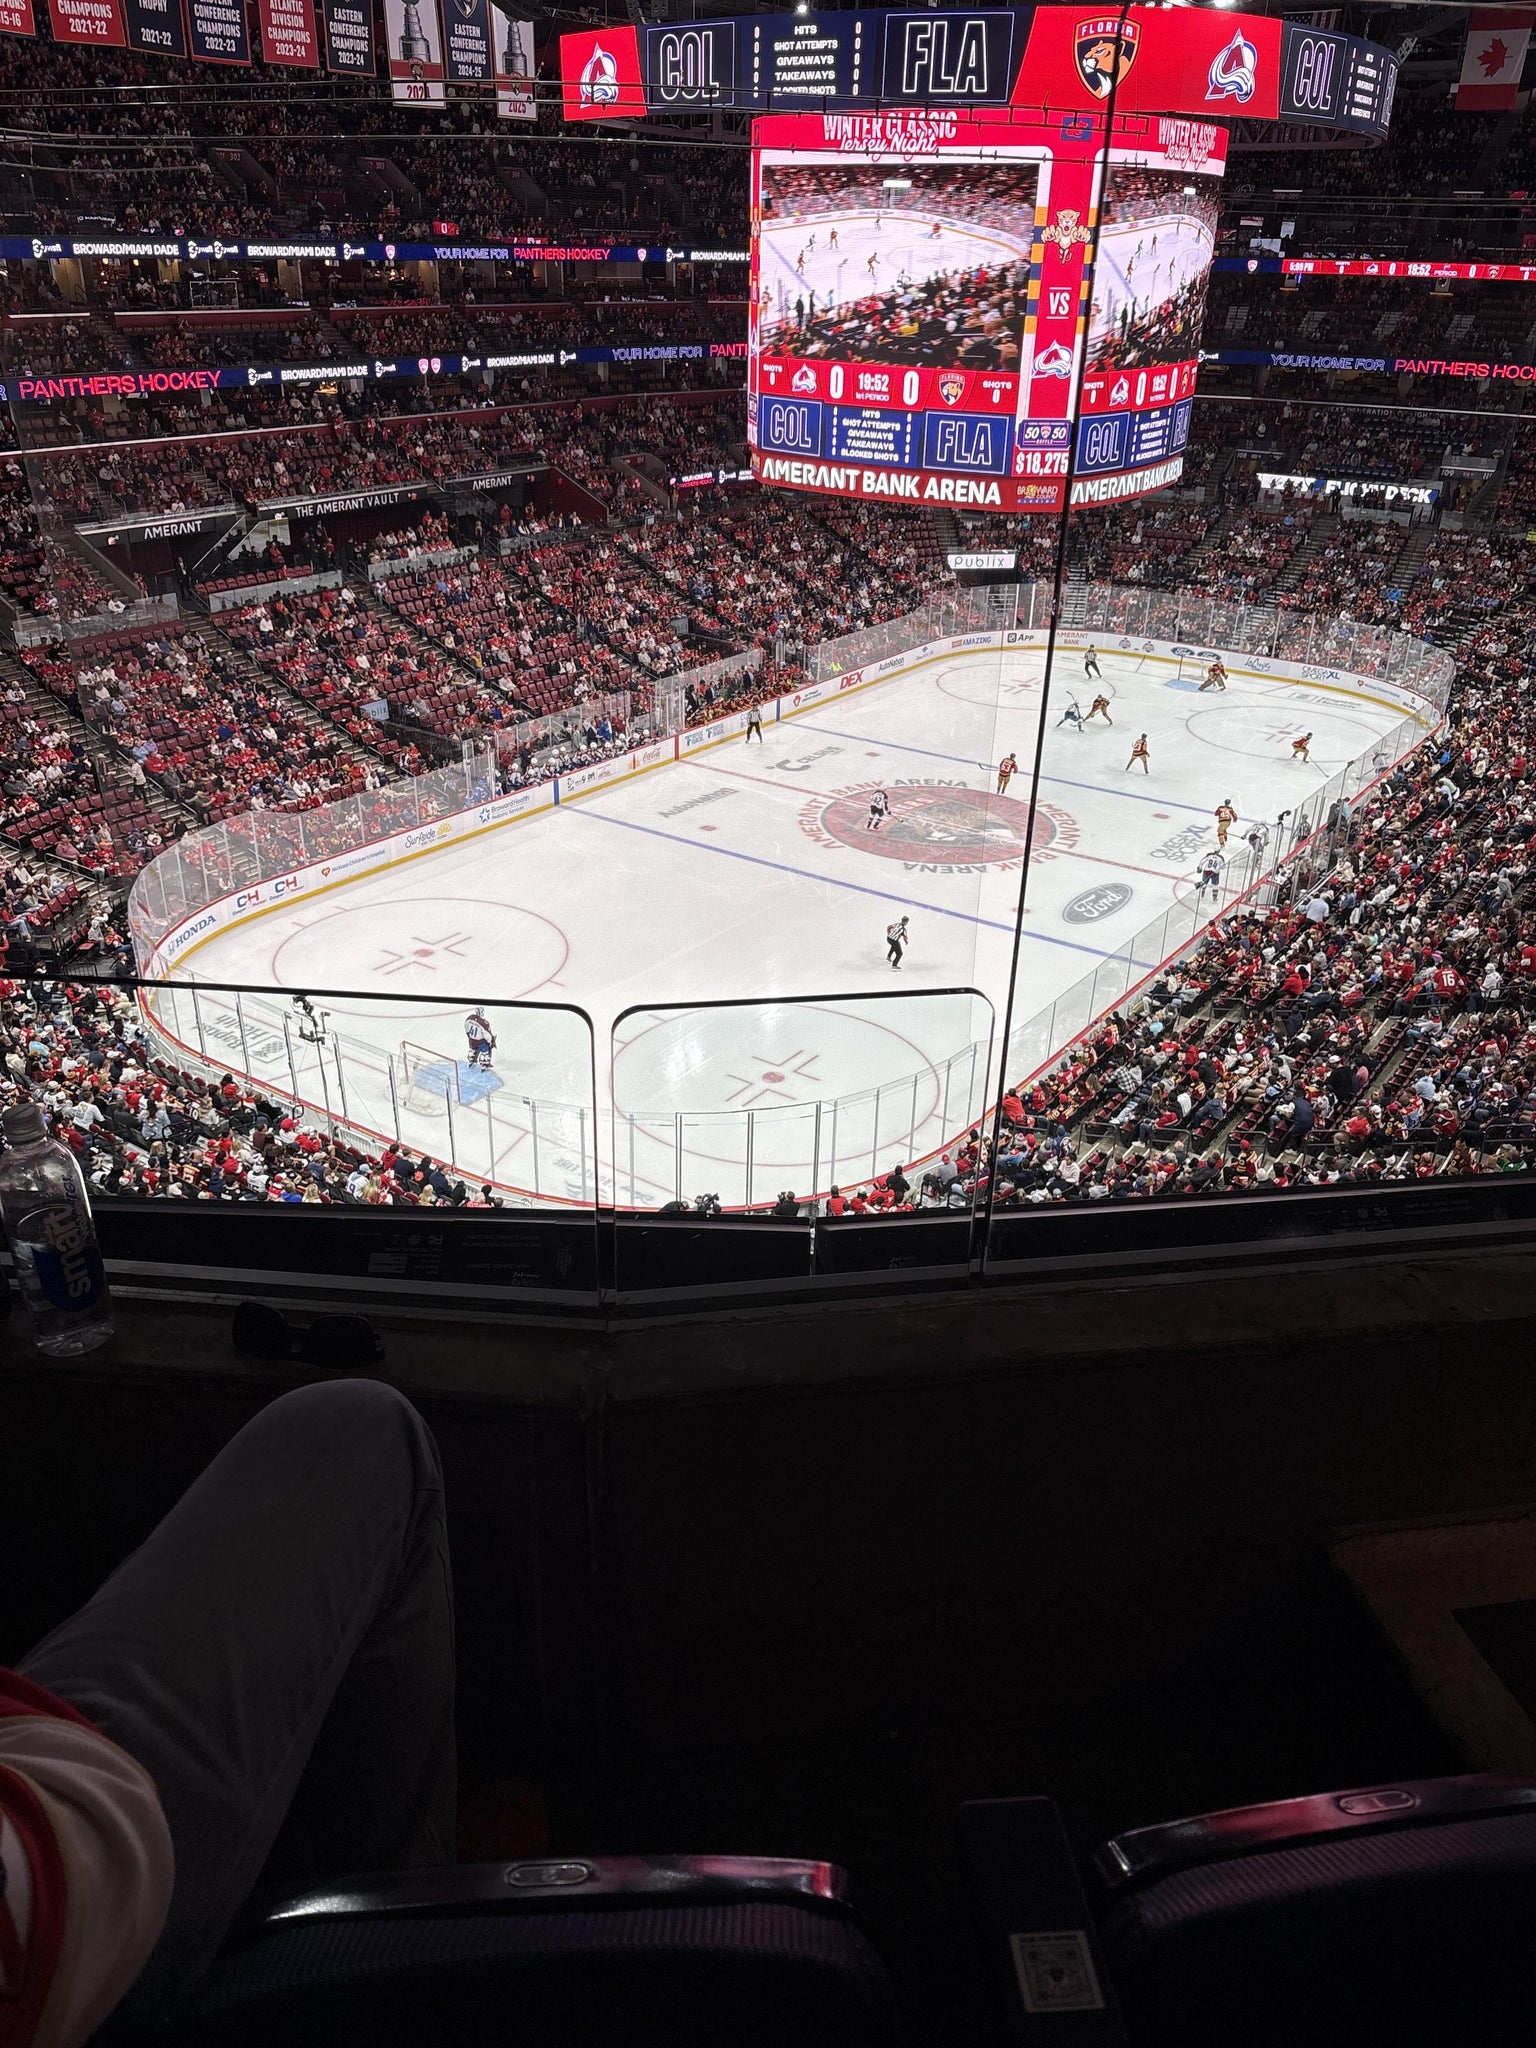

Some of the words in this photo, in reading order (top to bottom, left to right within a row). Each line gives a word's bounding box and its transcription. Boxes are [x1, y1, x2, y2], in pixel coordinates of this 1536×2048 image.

[57, 0, 113, 19] CHAMPIONS
[194, 4, 241, 22] CONFERENCE
[334, 8, 363, 23] EASTERN
[69, 18, 108, 35] 2021-22
[271, 12, 304, 28] DIVISION
[141, 27, 172, 46] 2021-22
[197, 20, 241, 38] CHAMPIONS
[267, 27, 311, 44] CHAMPIONS
[329, 21, 369, 38] CONFERENCE
[454, 24, 480, 37] EASTERN
[794, 25, 817, 35] HITS
[205, 36, 236, 52] 2022-23
[276, 43, 306, 58] 2023-24
[331, 36, 369, 53] CHAMPIONS
[450, 36, 486, 51] CONFERENCE
[774, 41, 795, 51] SHOT
[796, 39, 839, 50] ATTEMPTS
[338, 51, 364, 66] 2023-24
[452, 51, 486, 64] CHAMPIONS
[776, 55, 835, 66] GIVEAWAYS
[903, 21, 987, 93] FLA
[457, 65, 482, 77] 2024-25
[660, 31, 720, 100] COL
[775, 70, 836, 81] TAKEAWAYS
[1293, 38, 1336, 110] COL
[809, 85, 837, 95] SHOTS
[823, 113, 883, 140] WINTER
[886, 110, 957, 138] CLASSIC
[1158, 118, 1190, 145] WINTER
[840, 134, 889, 162] Jersey
[890, 131, 938, 162] Night
[73, 243, 152, 255] BROWARD/MIAMI
[154, 244, 179, 255] DADE
[315, 246, 336, 257] DADE
[434, 247, 461, 260] YOUR
[462, 248, 488, 260] HOME
[489, 248, 509, 260] FOR
[513, 248, 567, 260] PANTHERS
[567, 249, 610, 260] HOCKEY
[1389, 263, 1396, 275] 0
[1407, 264, 1430, 276] 19:52
[1468, 265, 1476, 277] 0
[1049, 292, 1070, 316] VS
[538, 353, 555, 364] DADE
[612, 348, 642, 361] YOUR
[643, 347, 677, 360] HOME
[678, 345, 702, 358] FOR
[347, 365, 368, 377] DADE
[1270, 353, 1309, 368] YOUR
[1310, 355, 1353, 370] HOME
[1354, 357, 1385, 372] FOR
[1394, 359, 1490, 377] PANTHERS
[19, 374, 136, 400] PANTHERS
[138, 370, 221, 393] HOCKEY
[829, 365, 844, 399] 0
[858, 372, 890, 392] 19:52
[903, 370, 920, 405] 0
[982, 380, 1012, 390] SHOTS
[1136, 371, 1147, 406] 0
[1169, 366, 1179, 400] 0
[992, 389, 1000, 404] 0
[862, 409, 881, 419] HITS
[769, 404, 812, 448] COL
[842, 418, 862, 428] SHOT
[862, 419, 901, 431] ATTEMPTS
[847, 429, 894, 441] GIVEAWAYS
[1024, 427, 1040, 439] 50
[1052, 427, 1067, 439] 50
[846, 439, 895, 451] TAKEAWAYS
[937, 419, 992, 465] FLA
[1085, 421, 1120, 465] COL
[841, 449, 873, 459] BLOCKED
[873, 451, 899, 461] SHOTS
[1015, 451, 1069, 476] $18,275
[472, 475, 513, 491] AMERANT
[762, 457, 861, 491] AMERANT
[862, 470, 921, 498] BANK
[923, 477, 1001, 505] ARENA
[1071, 473, 1143, 504] AMERANT
[1144, 466, 1166, 488] BANK
[295, 504, 314, 518] THE
[315, 498, 365, 516] AMERANT
[366, 492, 399, 509] VAULT
[144, 520, 202, 541] AMERANT
[954, 555, 1004, 568] Publix
[962, 636, 991, 646] AMAZING
[1063, 638, 1080, 646] BANK
[878, 657, 905, 672] AutoNation
[840, 670, 864, 690] DEX
[1326, 671, 1340, 680] XL
[491, 801, 513, 814] Broward
[513, 795, 530, 807] Health
[798, 798, 846, 849] AMERANT
[894, 778, 968, 788] ARENA
[405, 828, 436, 849] Surfside
[903, 861, 987, 874] ARENA
[1207, 859, 1218, 869] 84
[274, 876, 298, 894] CH
[236, 890, 260, 909] CH
[1075, 890, 1124, 918] Ford
[174, 914, 217, 949] HONDA
[1441, 973, 1455, 987] 16
[468, 1025, 478, 1038] 41
